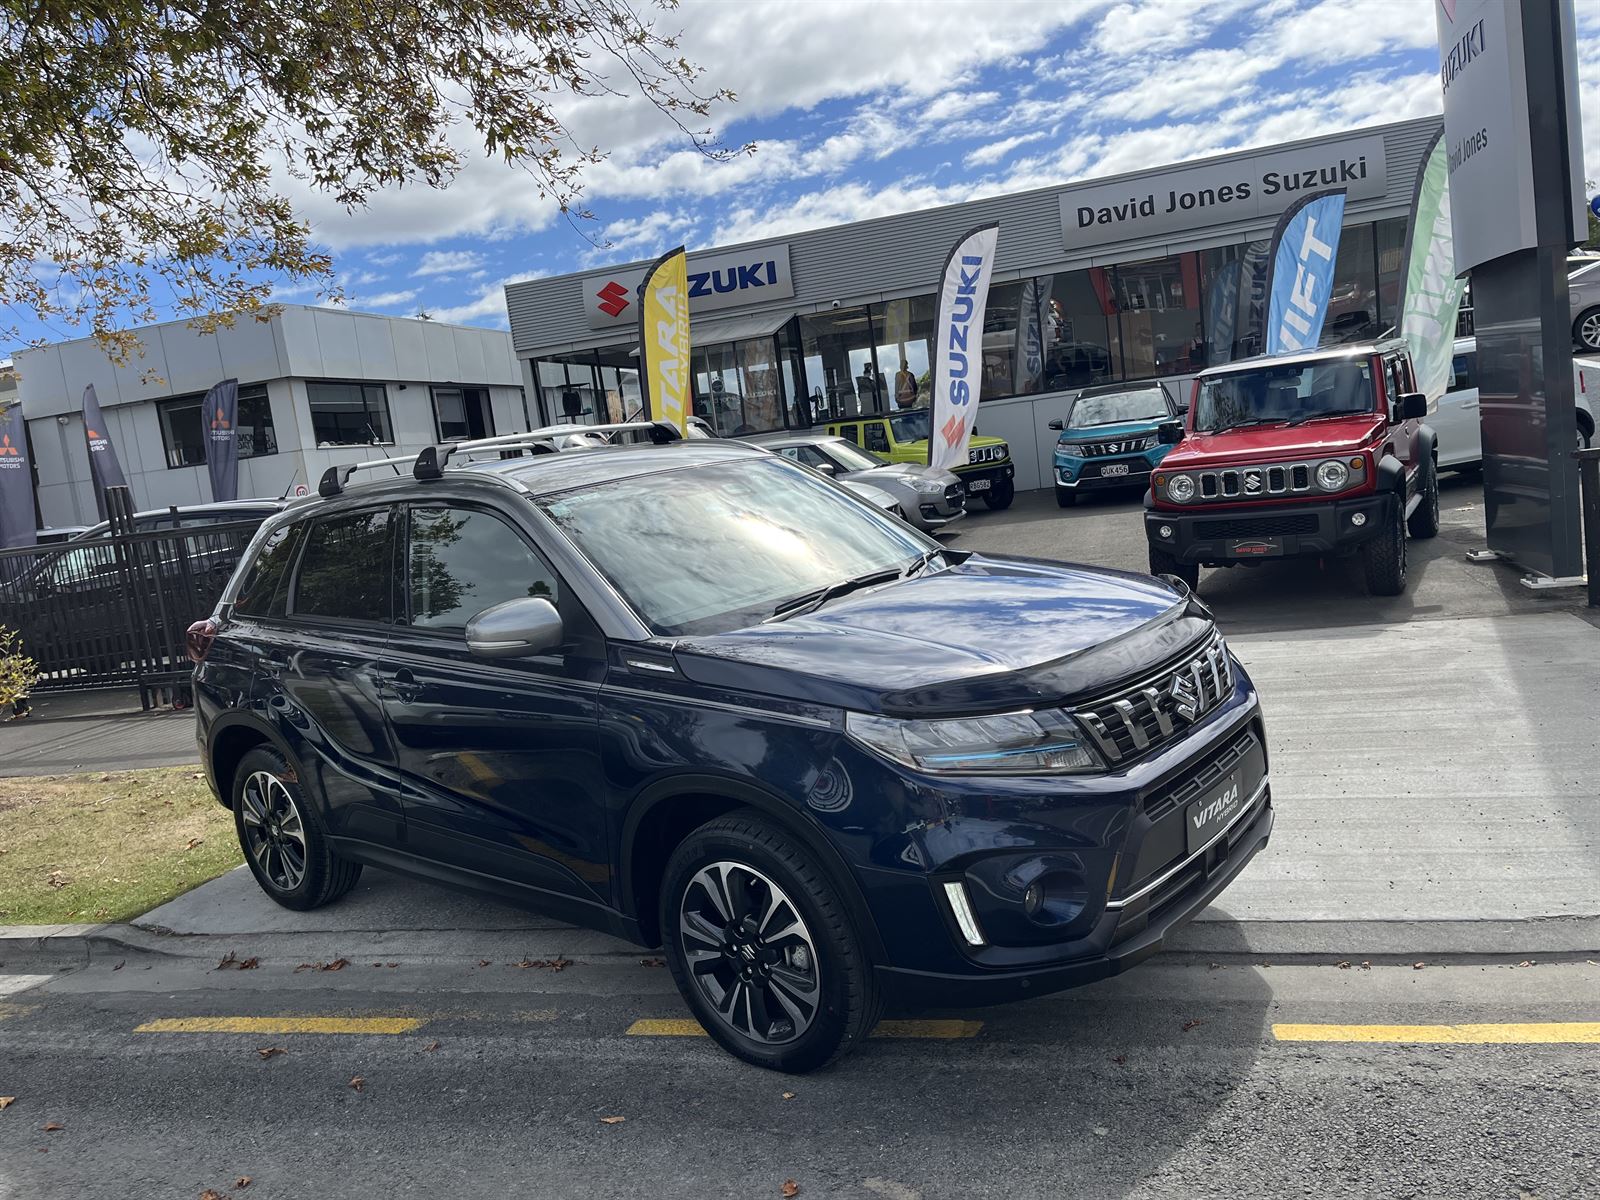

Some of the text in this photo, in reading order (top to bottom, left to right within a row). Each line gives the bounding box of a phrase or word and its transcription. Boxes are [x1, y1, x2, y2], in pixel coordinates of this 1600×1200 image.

[1463, 128, 1489, 163] Jones
[1077, 156, 1367, 229] David Jones Suzuki
[637, 260, 778, 299] ZUKI
[949, 256, 983, 407] SUZUKI
[1193, 784, 1238, 829] VITARA
[1216, 799, 1239, 823] HYBRID
